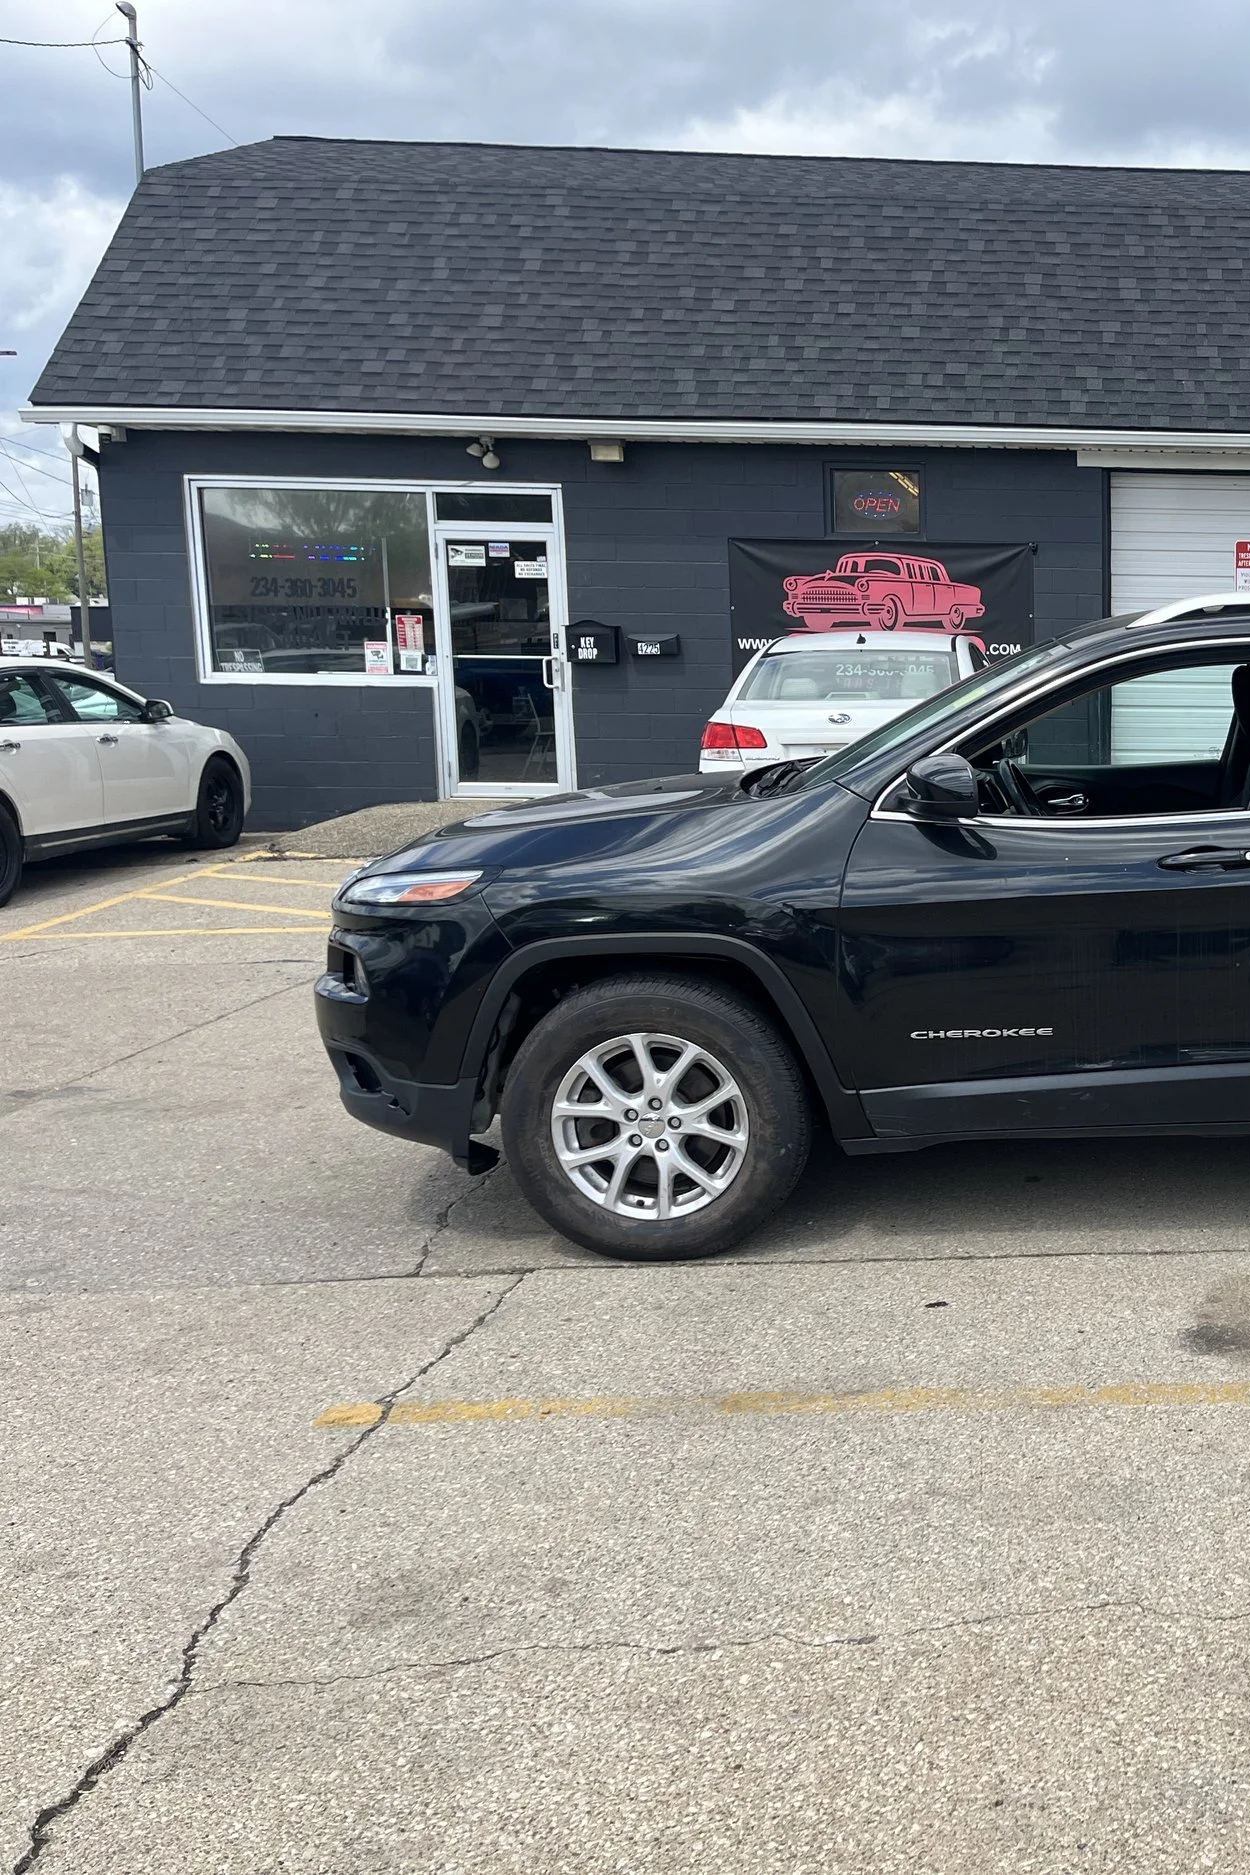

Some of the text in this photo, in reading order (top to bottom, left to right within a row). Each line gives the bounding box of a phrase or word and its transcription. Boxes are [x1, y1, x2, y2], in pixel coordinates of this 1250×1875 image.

[854, 498, 900, 512] OPEN
[251, 576, 357, 599] 234-360-3045
[580, 637, 594, 648] KEY
[637, 643, 661, 654] 4225
[234, 651, 245, 662] NO
[578, 648, 598, 660] DROP
[910, 1027, 1054, 1039] CHEROKEE
